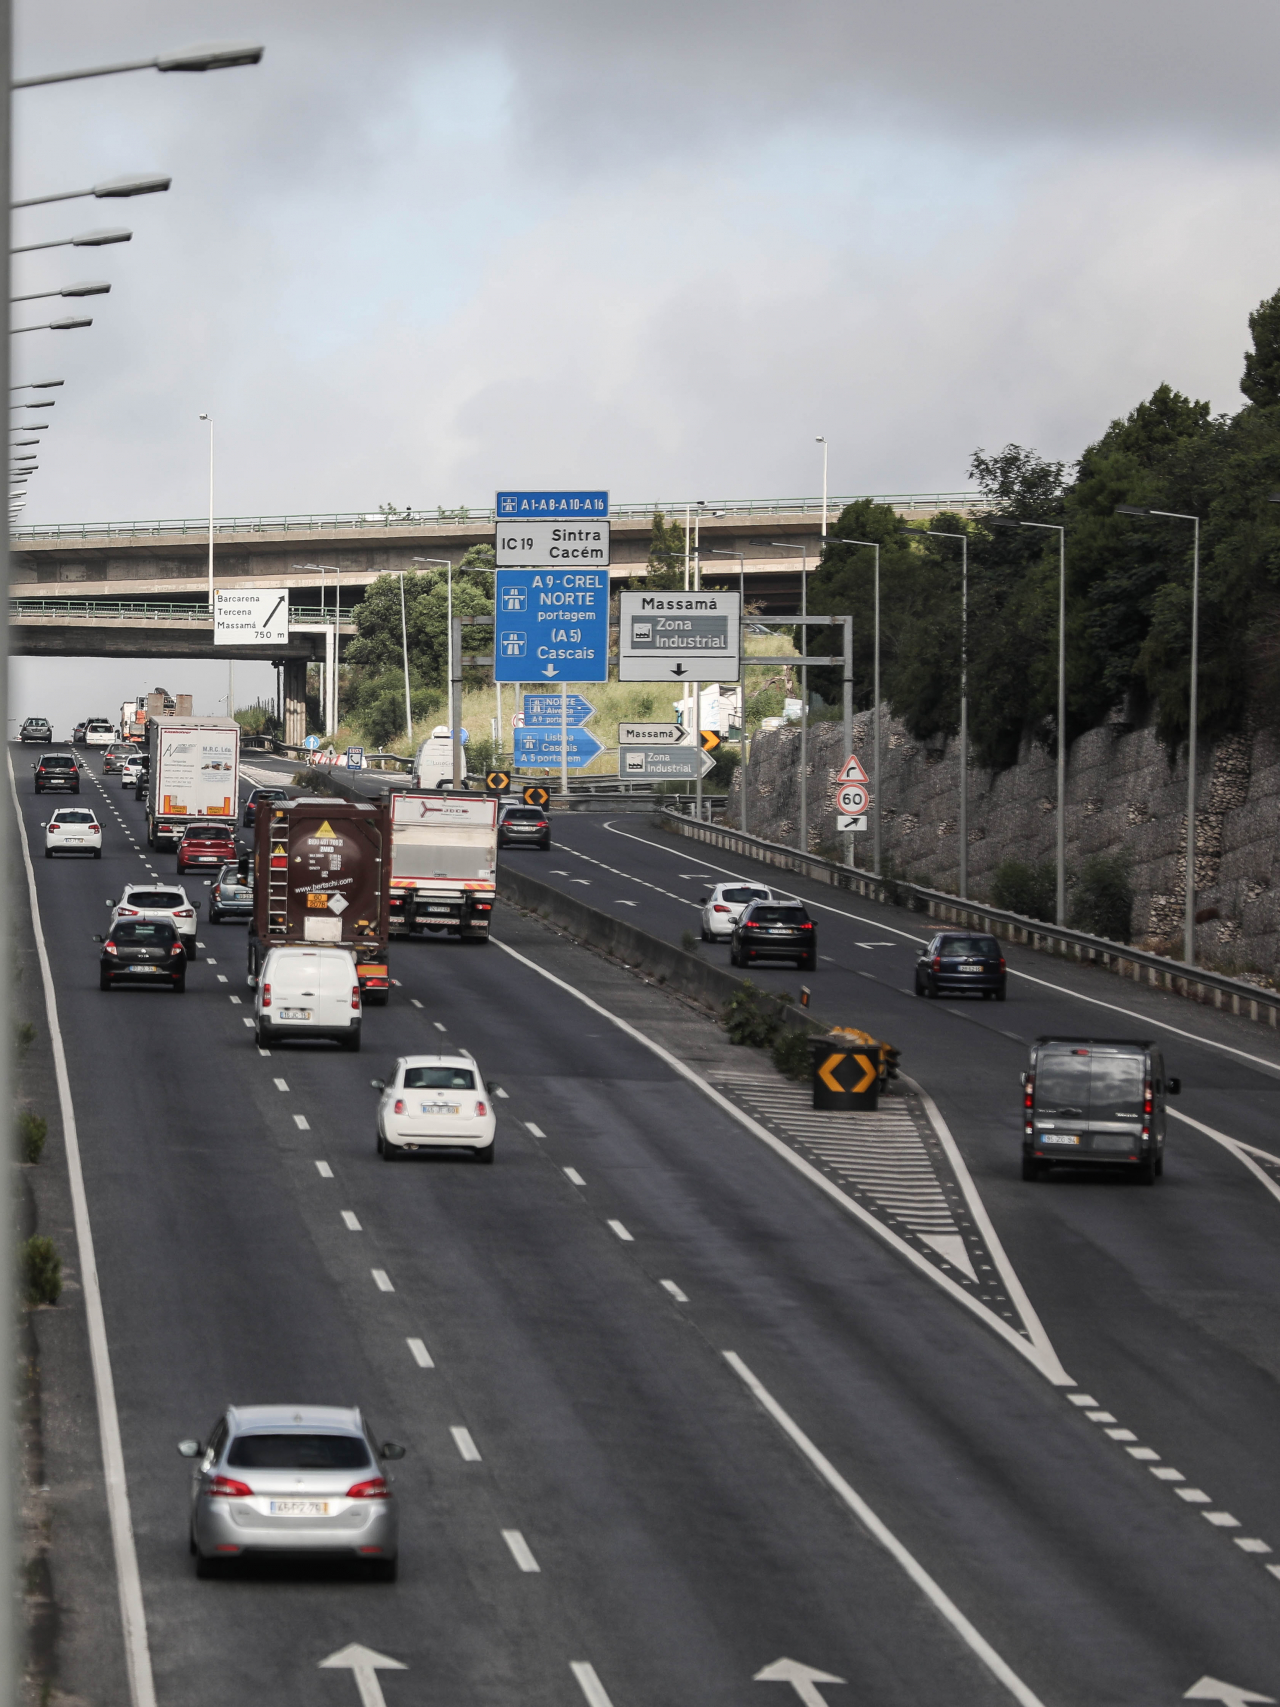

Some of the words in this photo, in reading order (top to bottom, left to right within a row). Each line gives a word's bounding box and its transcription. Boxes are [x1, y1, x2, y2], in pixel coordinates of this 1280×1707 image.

[552, 529, 601, 541] Sintra
[549, 546, 603, 558] Cacém
[540, 592, 595, 605] NORTE
[641, 597, 718, 610] Massamá
[538, 610, 596, 622] portagem
[217, 621, 256, 629] Massamá
[656, 618, 692, 630] Zona
[254, 631, 271, 639] 750
[656, 635, 725, 648] Industrial
[537, 646, 595, 659] Cascais
[545, 733, 574, 741] Lisba
[626, 727, 674, 738] Massamá
[538, 755, 581, 763] portaem
[647, 752, 670, 761] Zona
[648, 763, 692, 773] Industrial
[843, 793, 863, 805] 60
